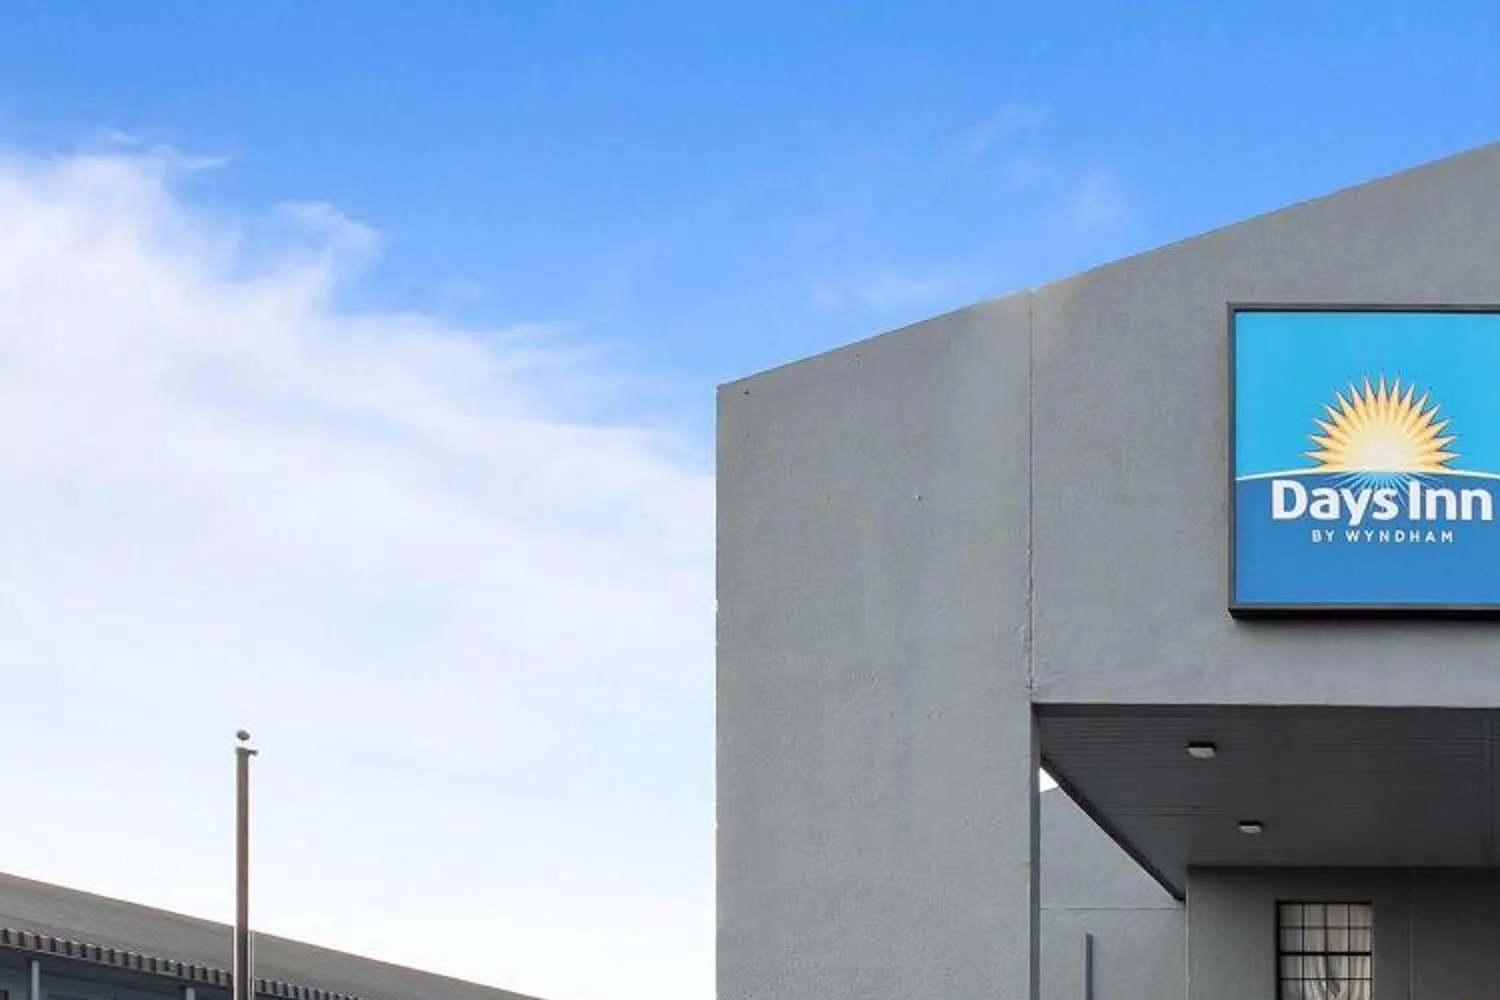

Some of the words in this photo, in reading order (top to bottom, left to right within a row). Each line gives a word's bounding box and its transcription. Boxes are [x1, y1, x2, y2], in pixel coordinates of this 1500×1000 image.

[1271, 480, 1399, 526] Days
[1410, 481, 1493, 521] Inn
[1311, 530, 1336, 542] BY
[1345, 530, 1454, 542] WYNDHAM
